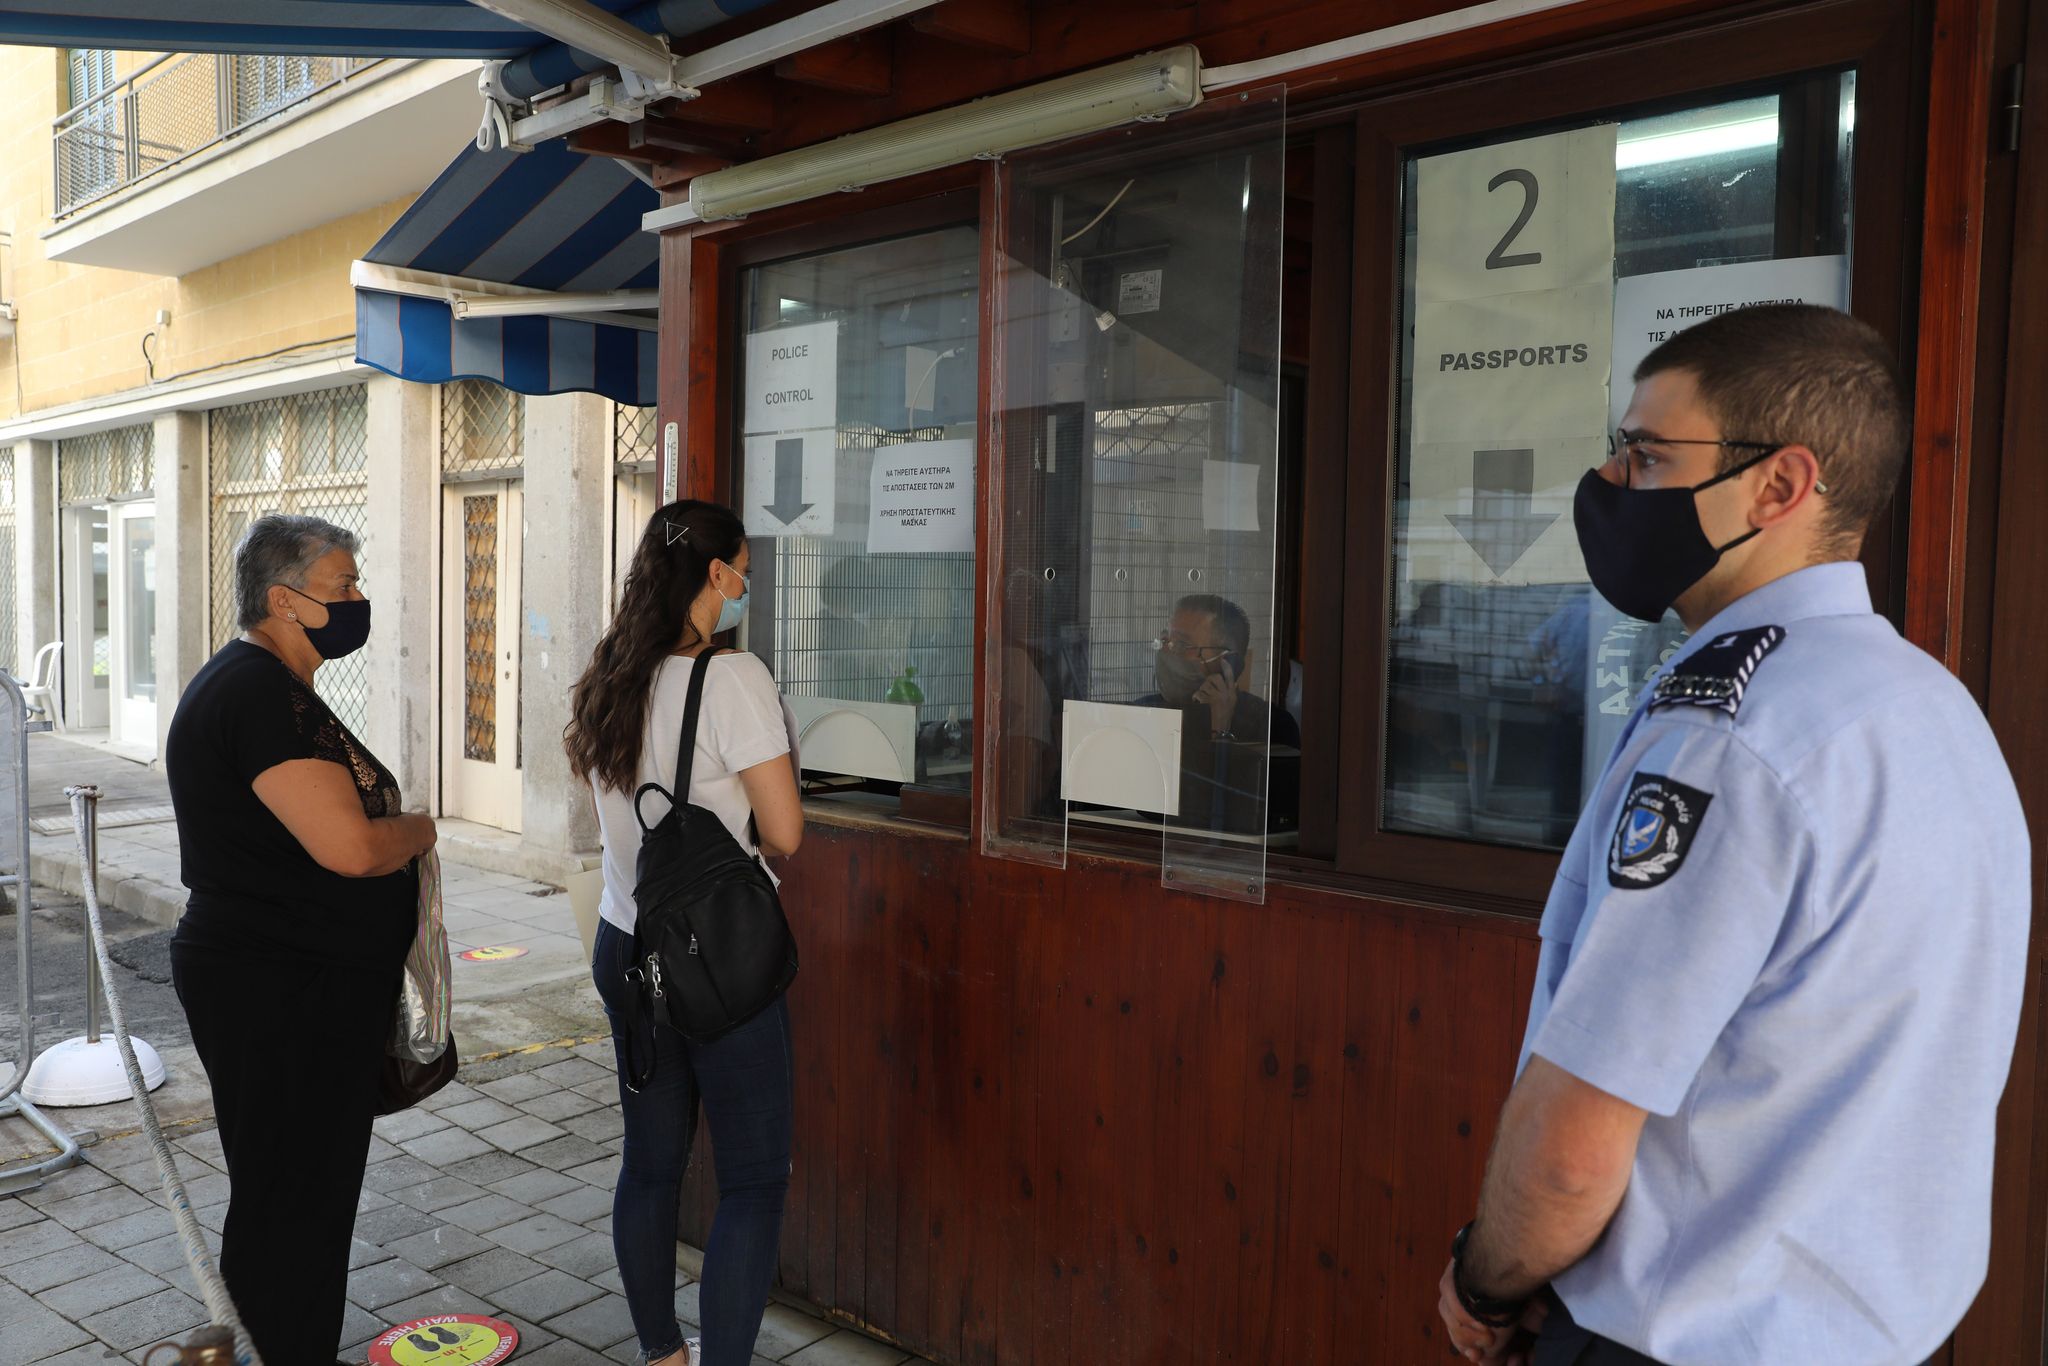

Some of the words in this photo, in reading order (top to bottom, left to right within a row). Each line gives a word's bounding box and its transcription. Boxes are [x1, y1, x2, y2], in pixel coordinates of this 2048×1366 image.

[1485, 168, 1542, 270] 2
[1656, 309, 1675, 320] ΝΑ
[1679, 303, 1734, 318] ΤΗΡΕΙΤΕ
[1648, 331, 1666, 343] ΤΙΣ
[772, 345, 808, 361] POLICE
[1440, 343, 1588, 372] PASSPORTS
[765, 389, 813, 405] CONTROL
[894, 468, 918, 477] ΤΗΡΕΙΤΕ
[919, 466, 951, 476] ΑΥΣΤΗΡΑ
[891, 483, 927, 492] ΑΠΟΣΤΑΣΕΙΣ
[929, 482, 943, 490] ΤΩΝ
[880, 509, 897, 517] ΧΡΗΣΗ
[898, 507, 956, 517] ΠΡΟΣΤΑΤΕΥΤΙΚΗΣ
[416, 1316, 458, 1329] WAIT
[378, 1325, 414, 1346] HERE
[470, 1335, 512, 1366] ΠΕΡΙΜΕΝ
